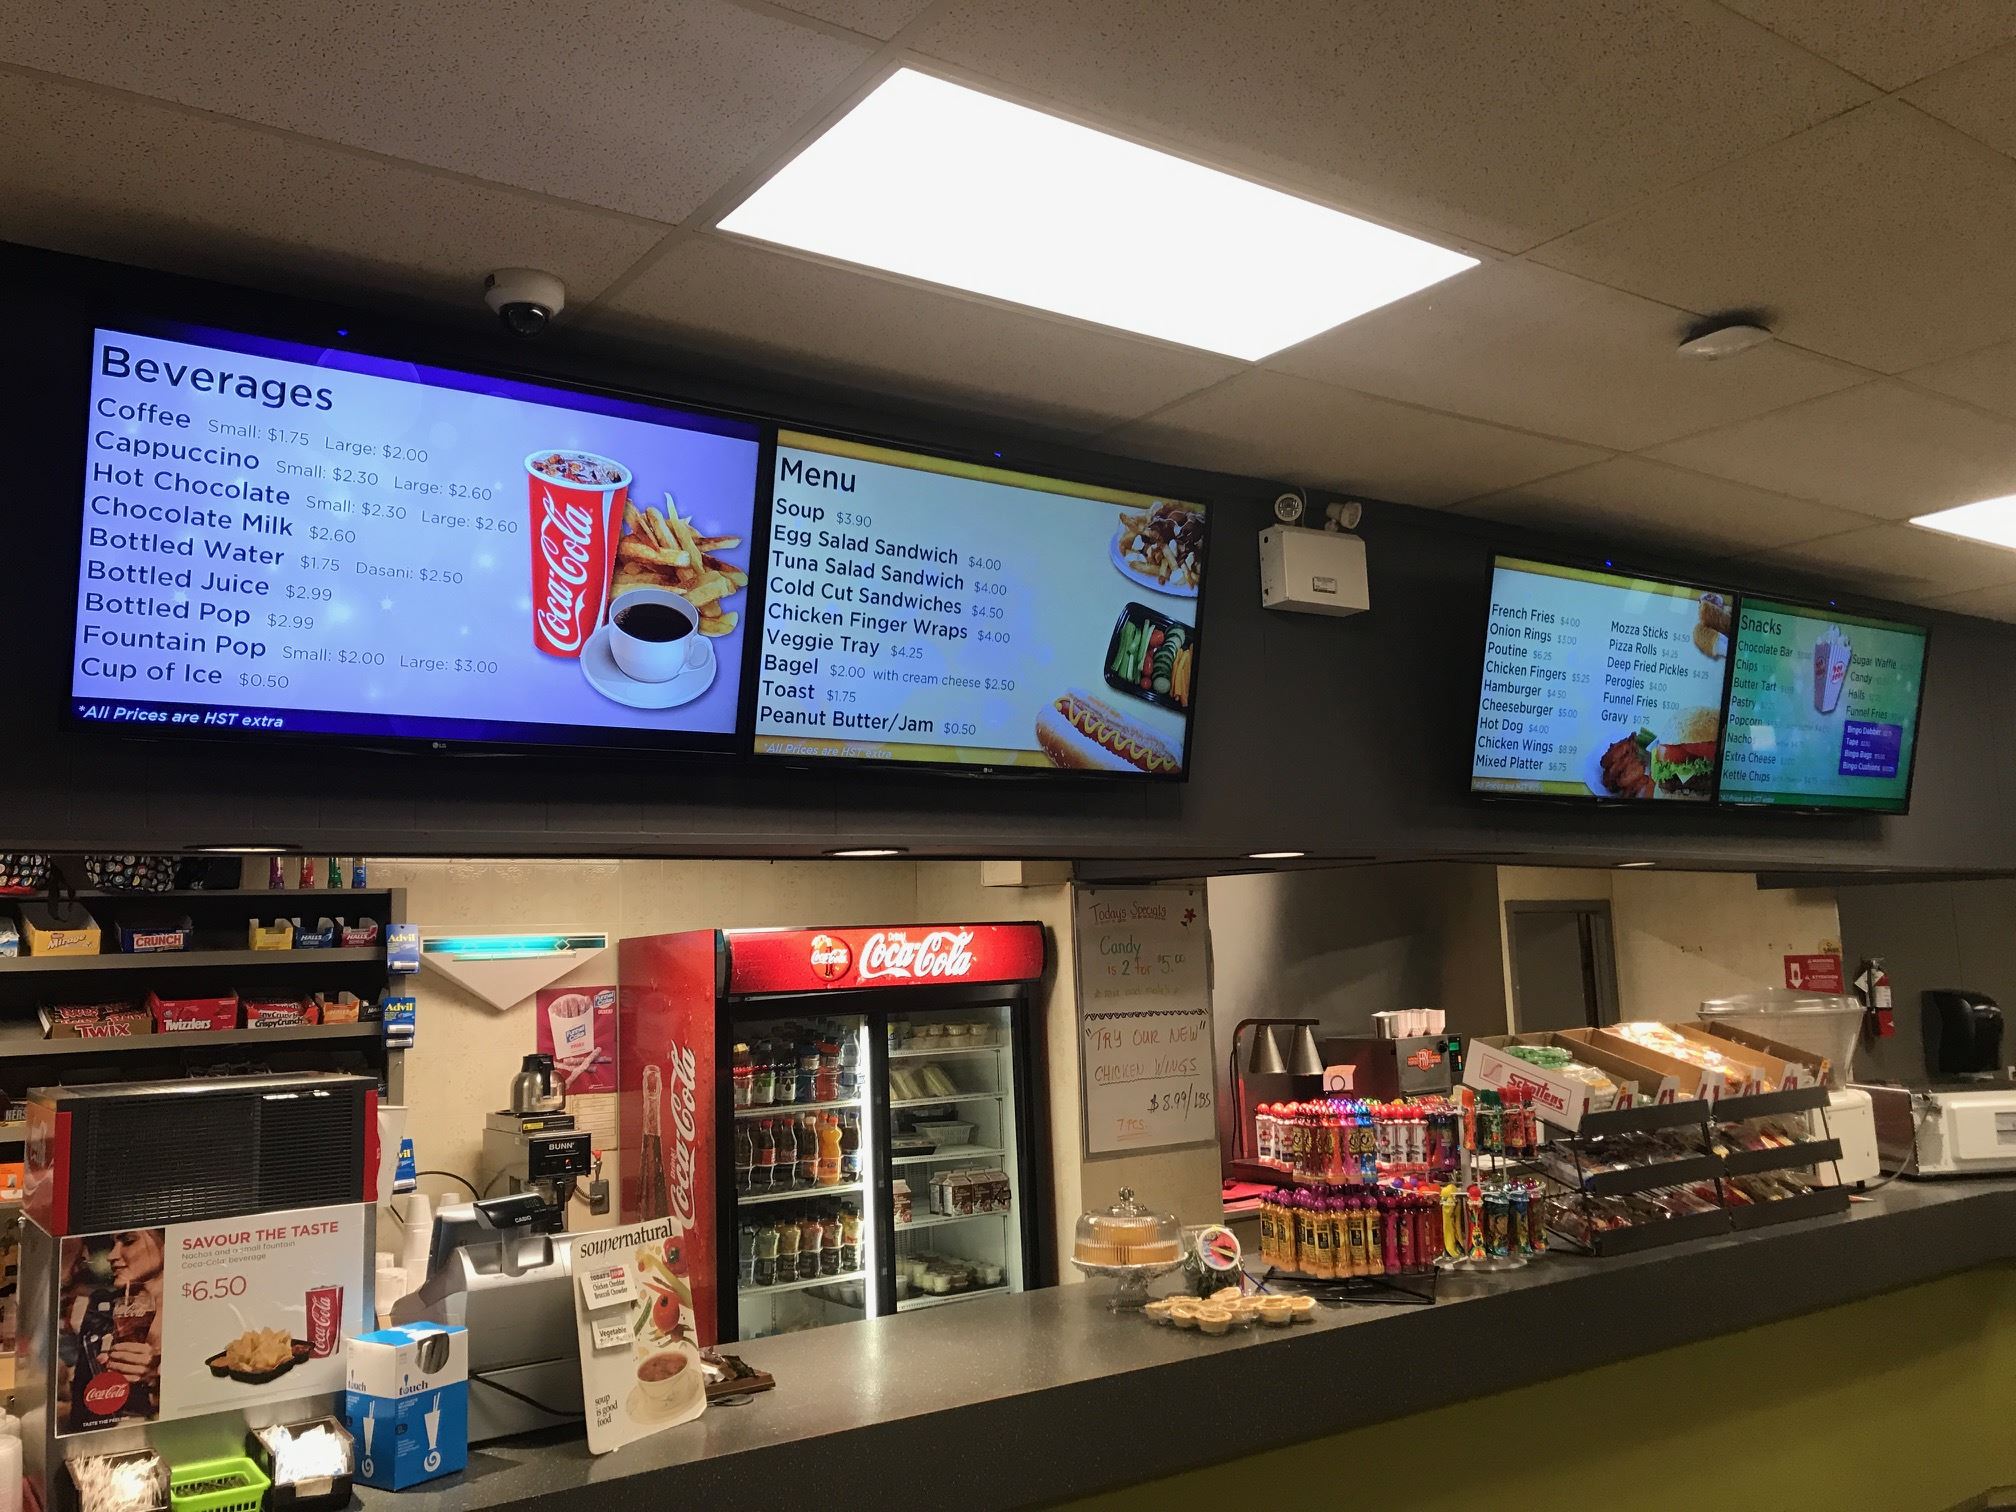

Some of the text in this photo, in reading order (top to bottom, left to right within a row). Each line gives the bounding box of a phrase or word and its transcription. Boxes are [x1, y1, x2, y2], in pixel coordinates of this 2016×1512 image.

[102, 345, 333, 411] Beverages
[97, 398, 428, 463] Coffee Small: $1.75 Large: $2.00
[95, 431, 492, 500] Cappuccino Small: $2.30 Large: $2.60
[781, 458, 856, 492] Menu
[93, 462, 518, 533] Hot Chocolate Small: $2.30 Large: $2.60
[91, 496, 356, 544] Chocolate Milk $2.60
[776, 498, 872, 527] Soup $3.90
[90, 528, 462, 584] Bottled Water $1.75 Dasani: $2.50
[774, 525, 1002, 570] Egg Salad Sandwich $4.00
[88, 560, 332, 601] Bottled Juice $2.99
[772, 551, 1007, 596] Tuna Salad Sandwich $4.00
[770, 577, 1004, 619] Cold Cut Sandwiches $4.50
[85, 593, 314, 630] Bottled Pop $2.99
[1492, 604, 1554, 624] French Fries
[768, 604, 1010, 644] Chicken Finger Wraps $4.00
[1490, 623, 1552, 643] Onion Rings
[1611, 621, 1668, 640] Mozza Sticks
[1741, 615, 1782, 636] Snacks
[83, 625, 498, 674] Fountain Pop Small: $2.00 Large: $3.00
[767, 628, 922, 659] Veggie Tray $4.25
[1488, 642, 1528, 658] Poutine
[1610, 639, 1657, 656] Pizza Rolls
[1738, 640, 1793, 657] Chocolate Bar
[81, 658, 288, 689] Cup of Ice $0.50
[765, 654, 1014, 691] Bagel $2.00 with cream cheese $2.50
[1486, 660, 1566, 682] Chicken Fingers
[1608, 656, 1688, 677] Deep Fried Pickles
[1736, 658, 1758, 672] Chips
[1606, 675, 1644, 690] Perogies
[1734, 678, 1776, 692] Butter Tart
[1850, 672, 1872, 685] Candy
[762, 680, 856, 702] Toast $1.75
[1484, 680, 1542, 698] Hamburger
[1482, 698, 1554, 717] Cheeseburger
[1603, 692, 1658, 708] Funnel Fries
[1732, 696, 1756, 710] Pastry
[114, 706, 283, 728] Prices are HST extra
[760, 706, 976, 736] Peanut Butter/Jam $0.50
[1480, 717, 1523, 734] Hot Dog
[1602, 710, 1628, 724] Gravy
[1730, 714, 1762, 726] Popcorn
[1478, 736, 1553, 754] Chicken Wings
[1476, 754, 1543, 770] Mixed Platter
[1725, 751, 1776, 765] Extra Cheese
[1723, 769, 1770, 782] Kettle Chips
[1090, 904, 1127, 922] Todays
[48, 934, 86, 950] Mirage
[136, 934, 182, 947] CRUNCH
[388, 934, 416, 942] Advil
[1100, 936, 1141, 957] Candy
[1121, 960, 1131, 976] 2
[1134, 957, 1151, 975] for
[385, 1003, 413, 1012] Advil
[75, 1022, 131, 1039] Twix
[164, 1018, 211, 1032] Twizzlers
[1132, 1028, 1160, 1045] OUR
[1094, 1056, 1197, 1083] CHICKEN WINGS
[515, 1216, 532, 1224] CASIO
[182, 1221, 339, 1251] SAVOUR THE TASTE
[580, 1218, 673, 1258] soupernatural
[182, 1253, 266, 1270] Coca-Cola beverage
[182, 1276, 246, 1302] $6.50
[599, 1327, 626, 1338] Vegetable
[595, 1394, 610, 1406] soup
[596, 1402, 618, 1416] is good
[597, 1416, 612, 1428] food
